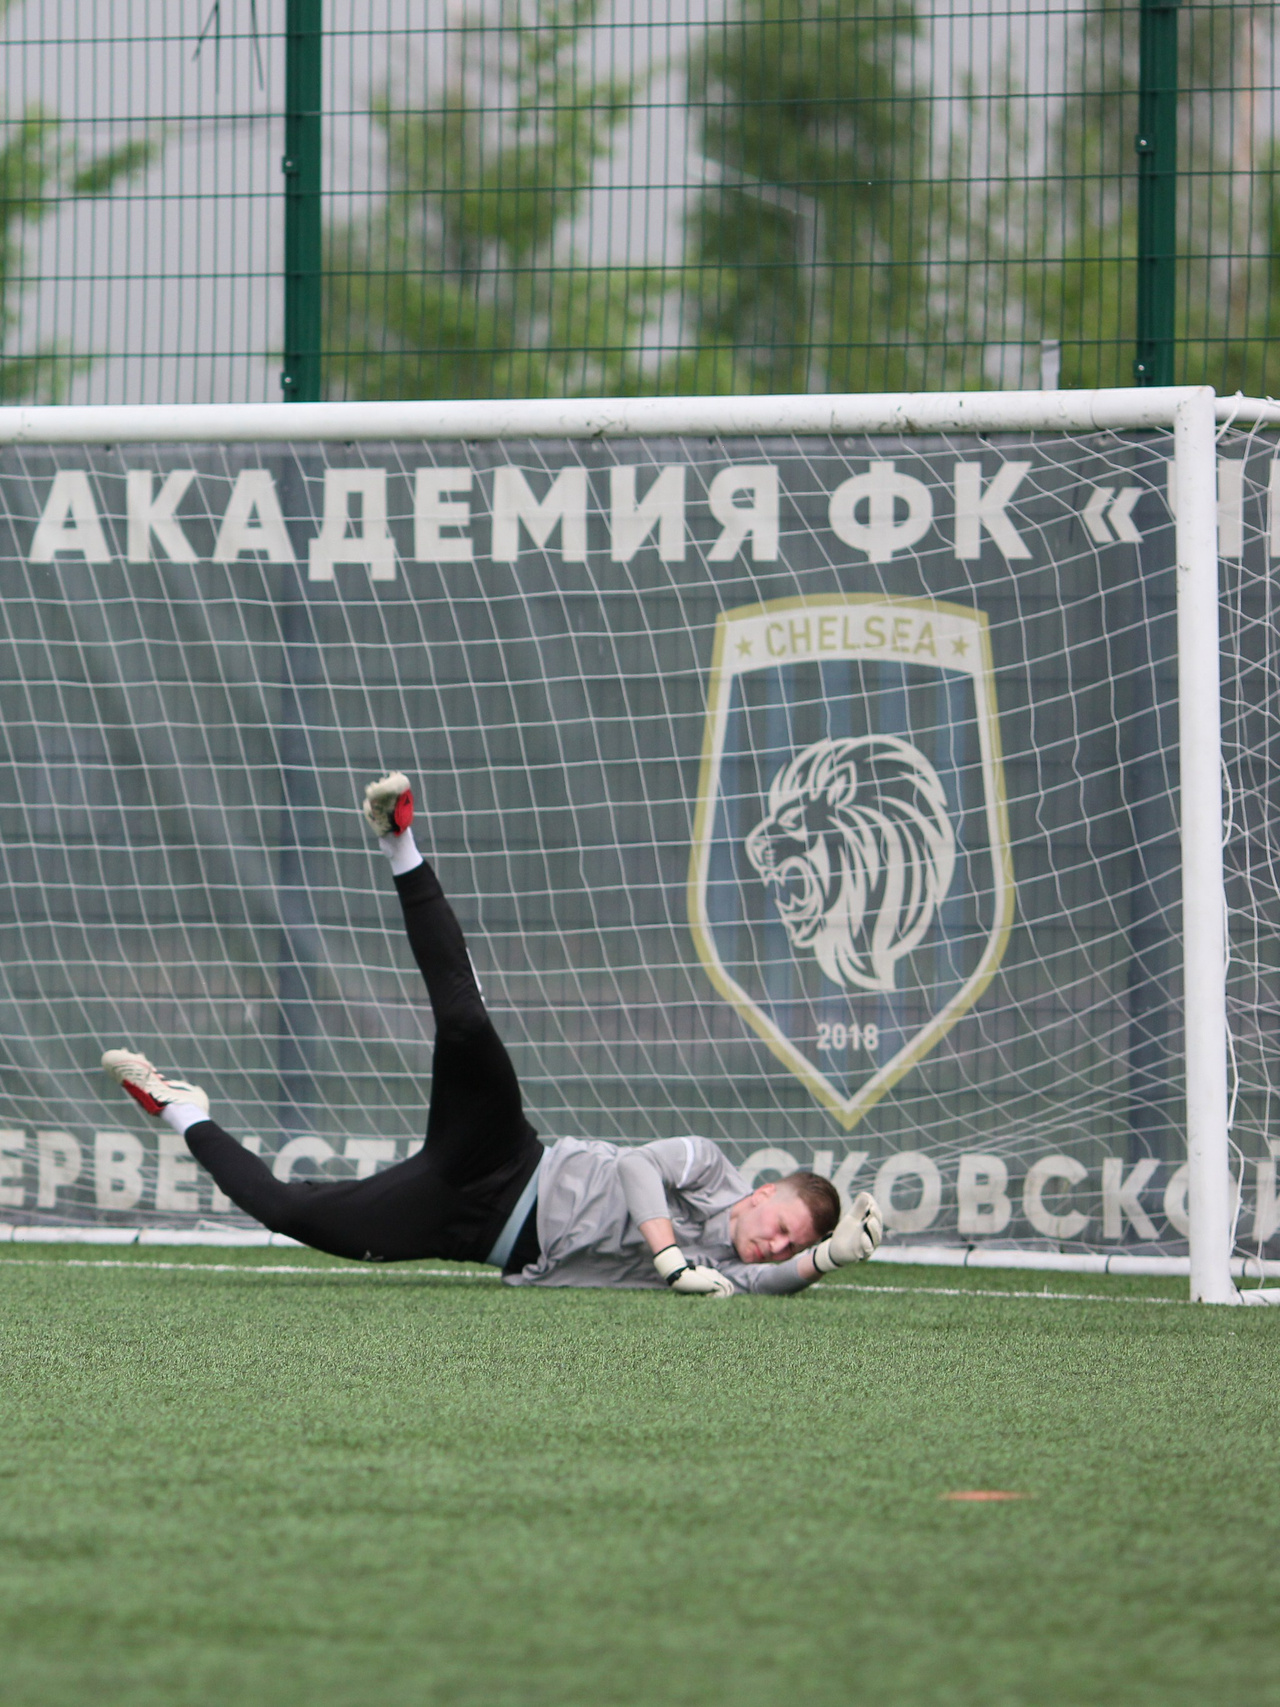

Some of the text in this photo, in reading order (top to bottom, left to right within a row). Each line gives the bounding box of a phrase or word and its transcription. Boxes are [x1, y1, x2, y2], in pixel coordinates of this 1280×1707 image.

[29, 465, 780, 582] АКАДЕМИЯ
[828, 460, 1033, 564] ФК
[765, 615, 937, 657] CHELSEA
[816, 1022, 879, 1051] 2018
